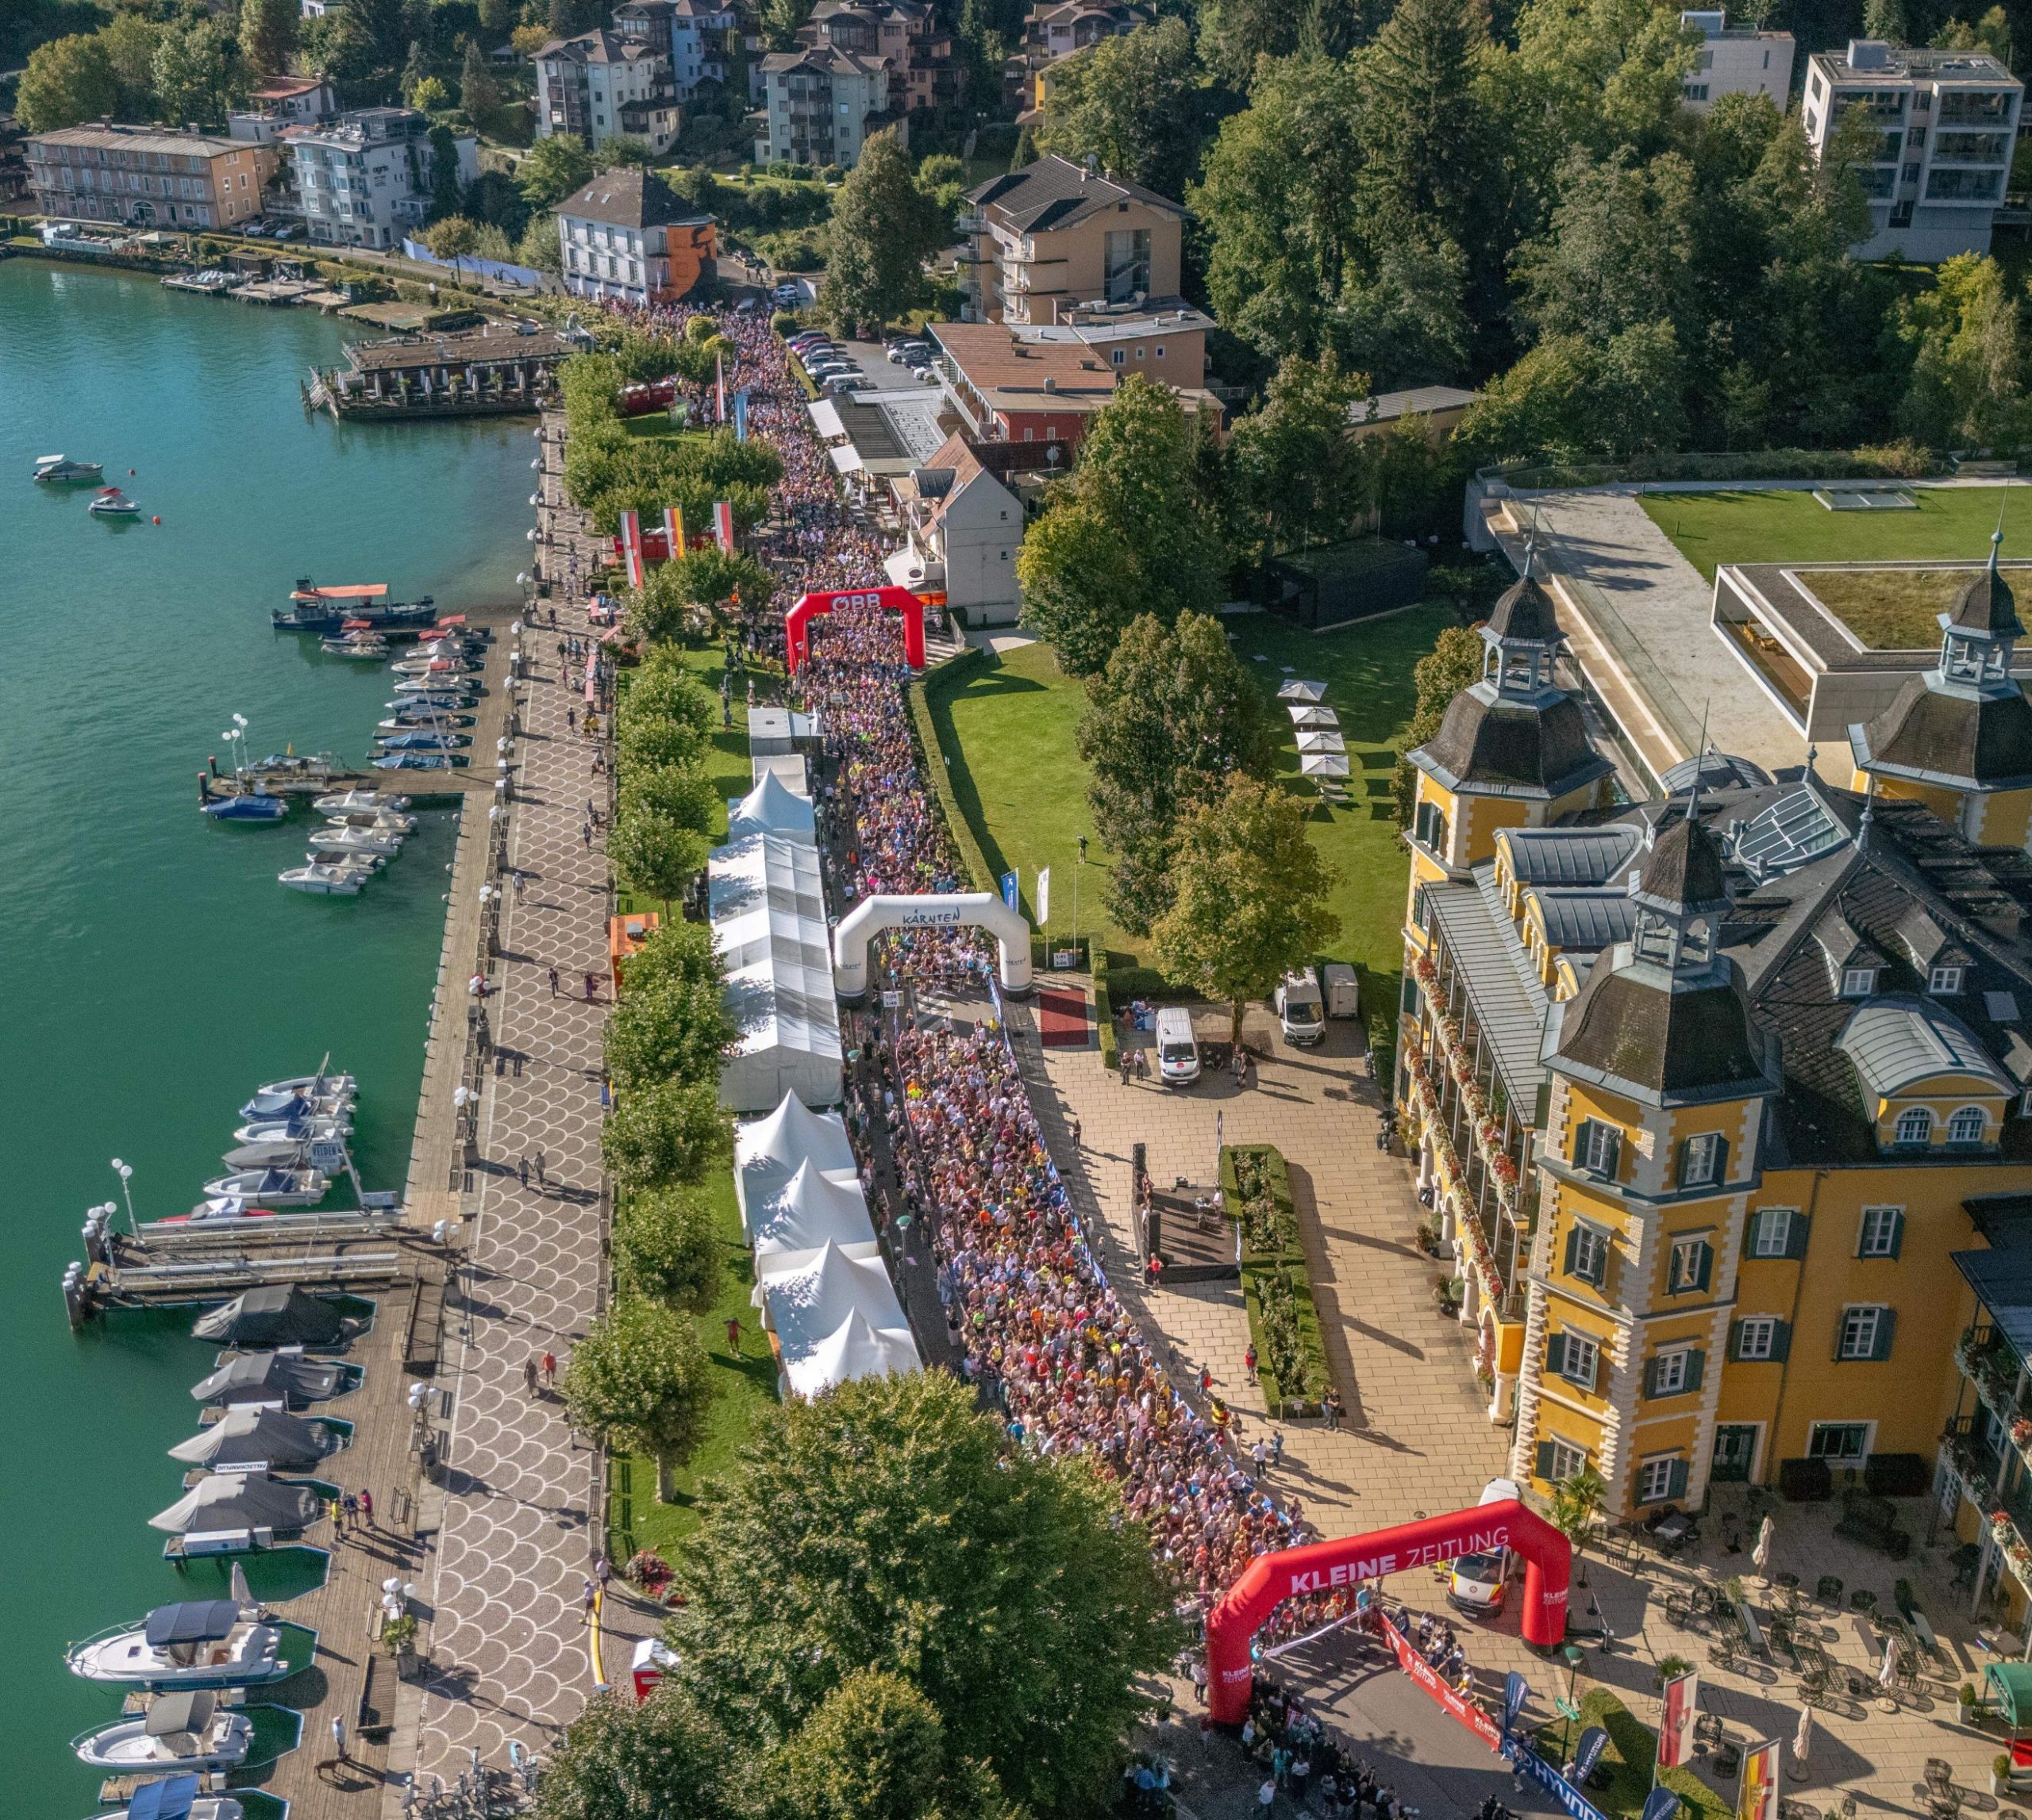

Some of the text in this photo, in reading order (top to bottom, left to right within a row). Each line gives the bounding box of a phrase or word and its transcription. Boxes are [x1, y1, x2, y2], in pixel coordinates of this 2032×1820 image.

[902, 906, 960, 925] KÄRNTEN
[1291, 1526, 1509, 1594] KLEINE ZEITUNG
[1584, 1733, 1607, 1766] HYUNDAI
